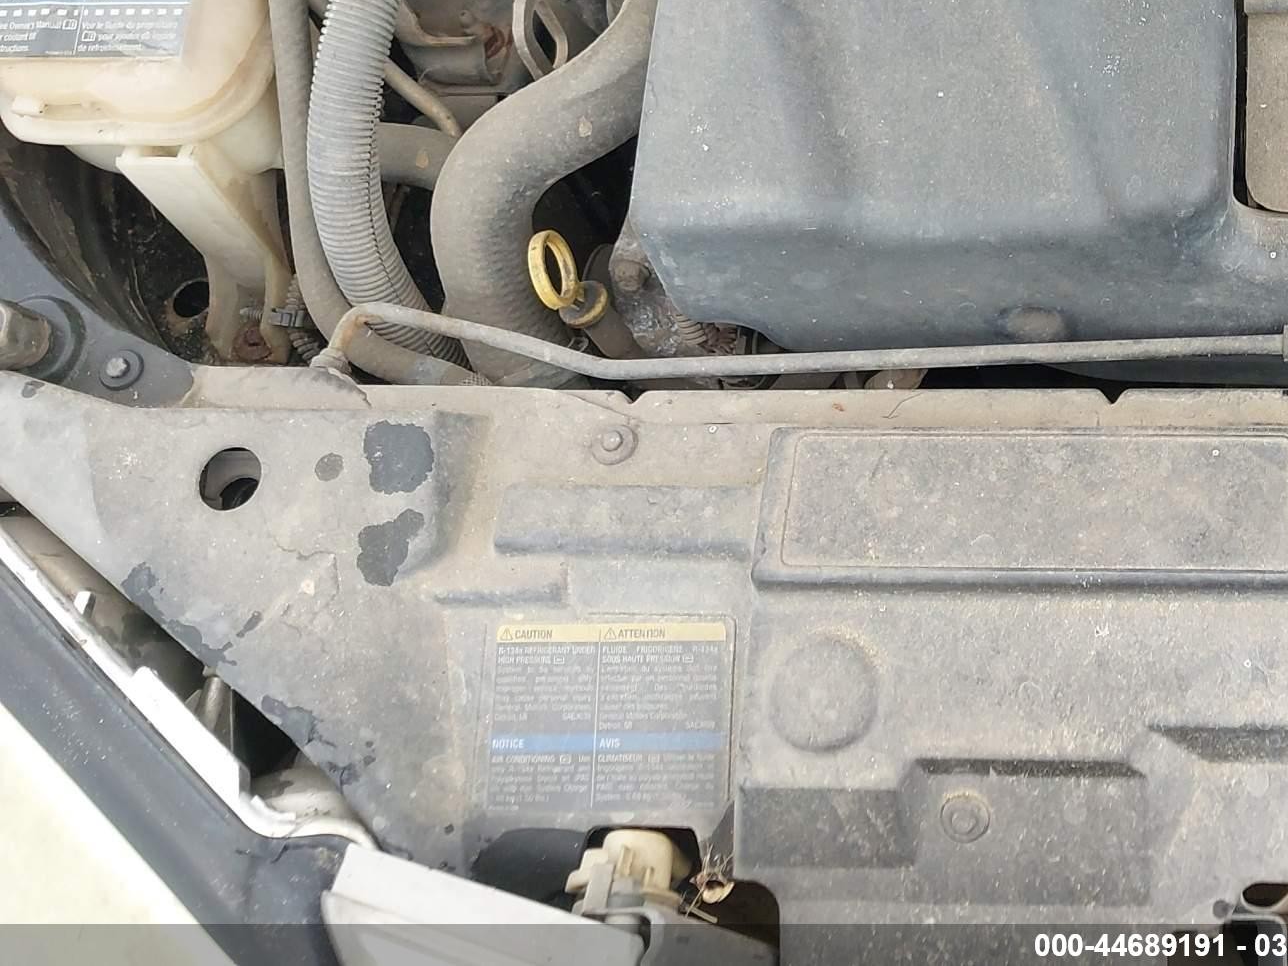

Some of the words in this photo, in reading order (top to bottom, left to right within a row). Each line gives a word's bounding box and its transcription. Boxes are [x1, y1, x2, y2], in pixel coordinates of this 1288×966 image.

[514, 629, 553, 640] CAUTION
[617, 627, 665, 639] ATTENTION
[622, 654, 645, 664] HAUTE
[491, 737, 525, 749] NOTICE
[599, 737, 621, 749] AVIS
